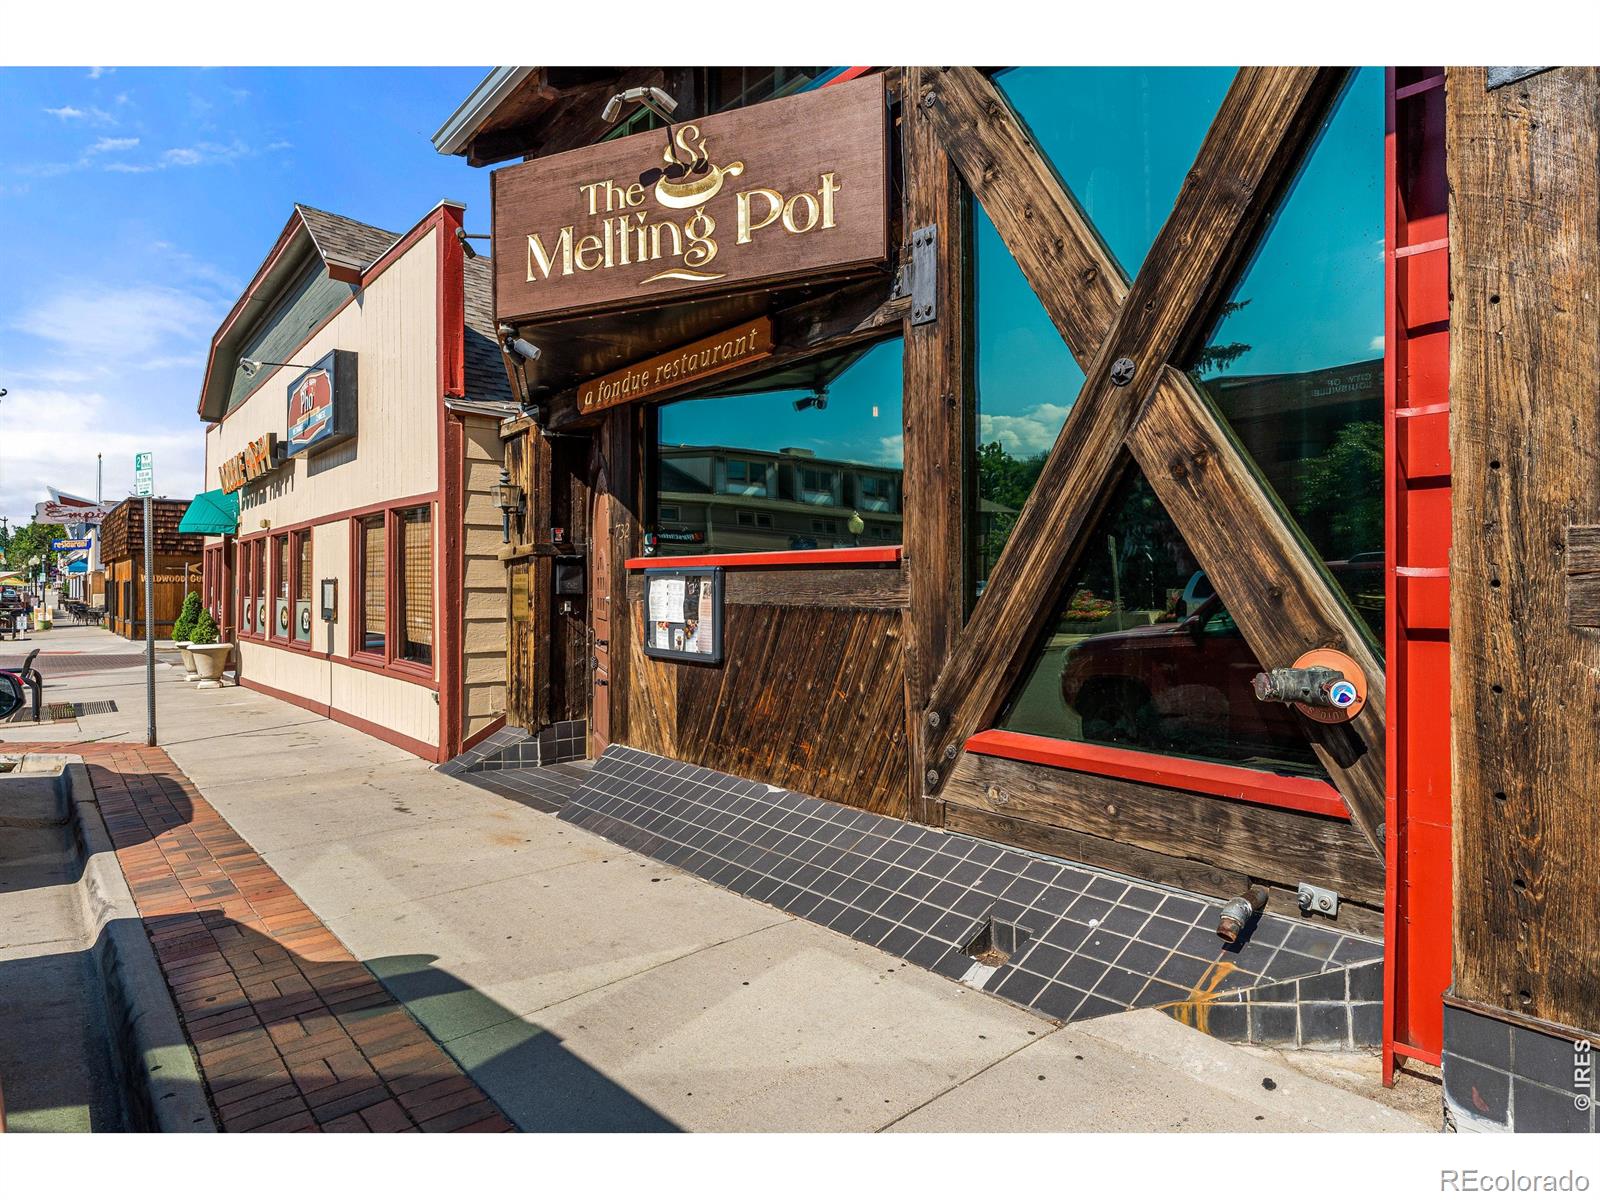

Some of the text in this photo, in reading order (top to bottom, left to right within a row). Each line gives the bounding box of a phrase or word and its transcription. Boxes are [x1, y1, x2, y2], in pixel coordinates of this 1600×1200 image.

[580, 180, 645, 216] The
[526, 173, 842, 282] Melting Pot
[584, 328, 758, 406] a fondue restaurant
[615, 524, 630, 540] 732
[140, 574, 204, 583] WDWOOD GU
